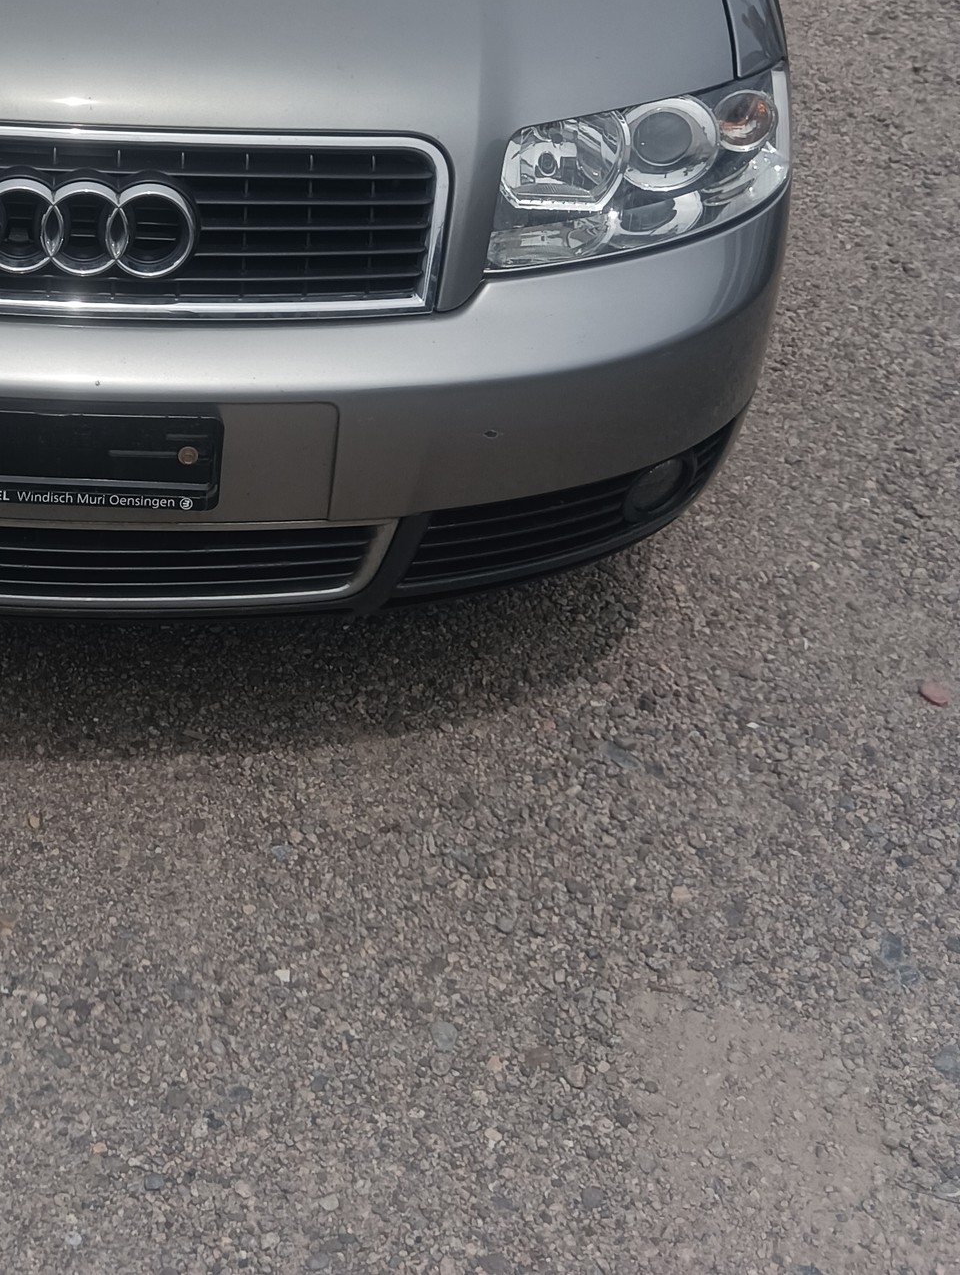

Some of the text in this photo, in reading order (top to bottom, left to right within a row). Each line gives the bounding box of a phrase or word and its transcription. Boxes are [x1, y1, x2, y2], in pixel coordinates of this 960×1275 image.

[16, 490, 74, 504] Windisch
[76, 493, 106, 505] Muri
[108, 494, 176, 509] Oensingen
